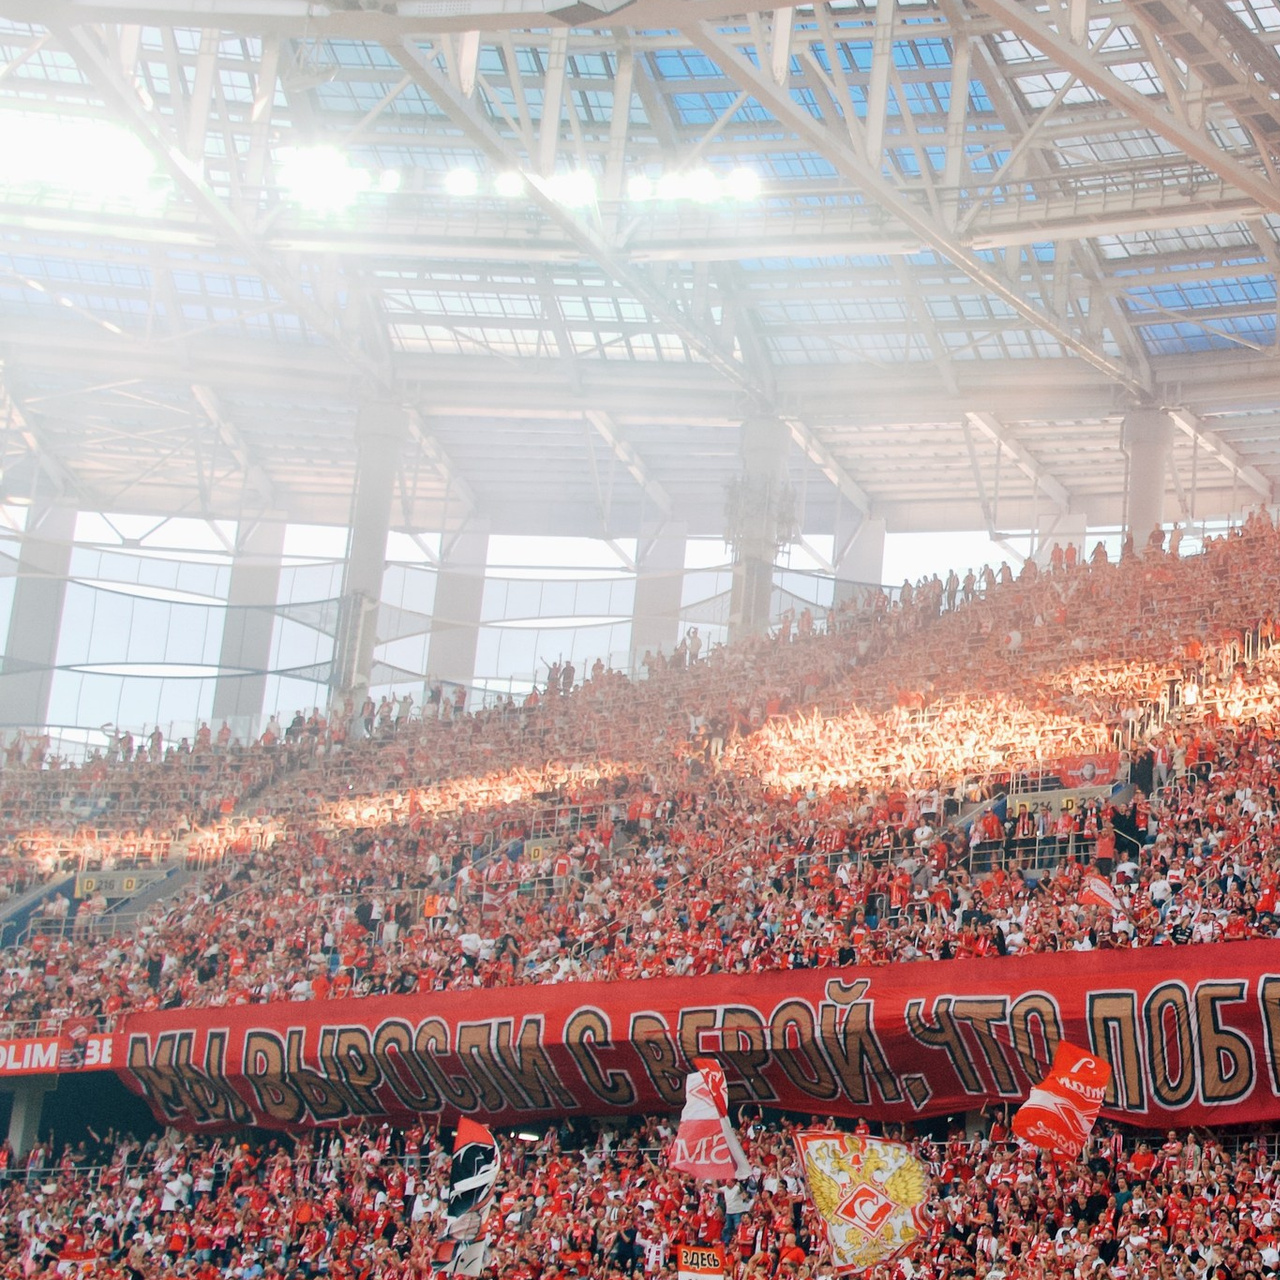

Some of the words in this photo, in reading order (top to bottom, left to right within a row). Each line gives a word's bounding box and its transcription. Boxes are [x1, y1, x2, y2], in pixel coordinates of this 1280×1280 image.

[1066, 798, 1074, 811] D
[86, 879, 94, 890] D
[127, 1027, 257, 1126] МЫ
[243, 1014, 582, 1123] ВЫРОСЛИ
[563, 1003, 639, 1107] С
[904, 990, 1066, 1096] ЧТО
[682, 1250, 720, 1269] ЗДЕСЬ
